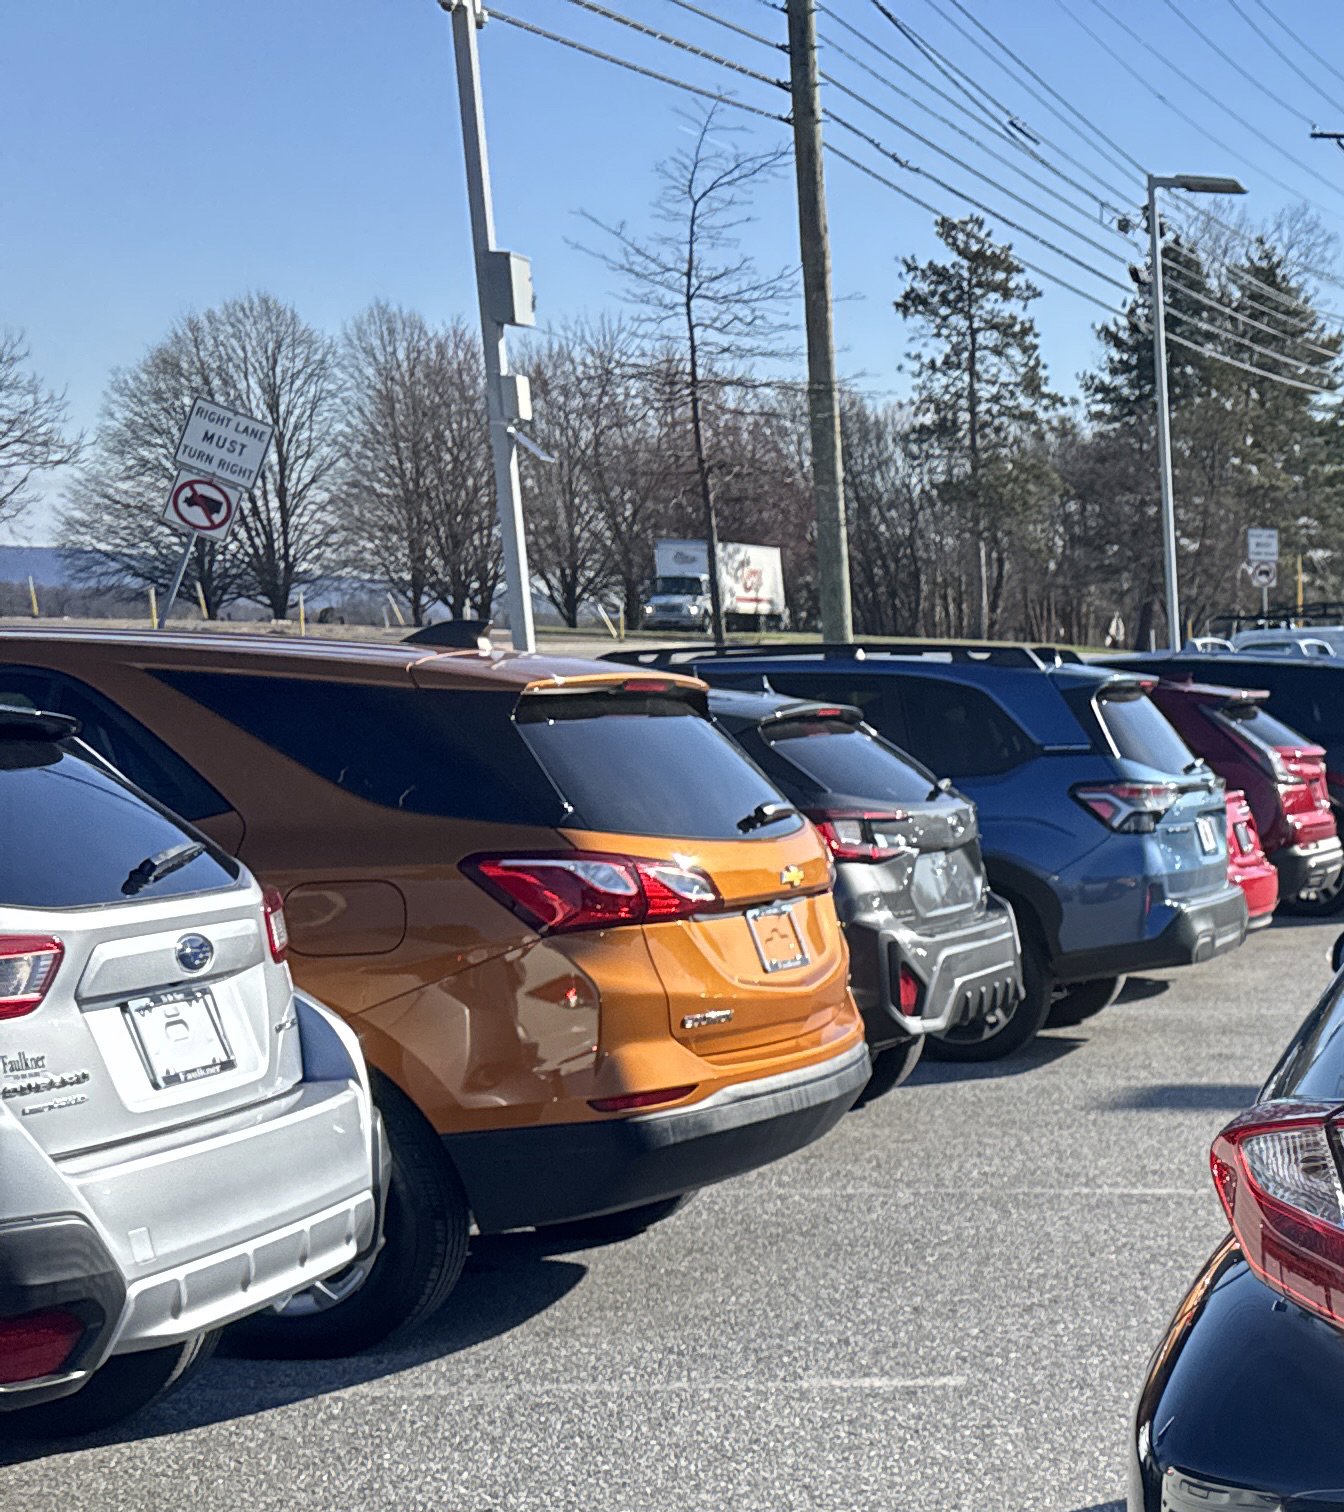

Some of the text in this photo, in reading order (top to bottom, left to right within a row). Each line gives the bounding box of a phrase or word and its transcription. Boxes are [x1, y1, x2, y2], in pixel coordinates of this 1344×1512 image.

[195, 406, 267, 443] RIGHT LANE
[201, 429, 248, 457] MUST
[182, 444, 255, 480] TURN RIGHT
[0, 1051, 46, 1074] Faulkner
[178, 1065, 222, 1082] Faulkner
